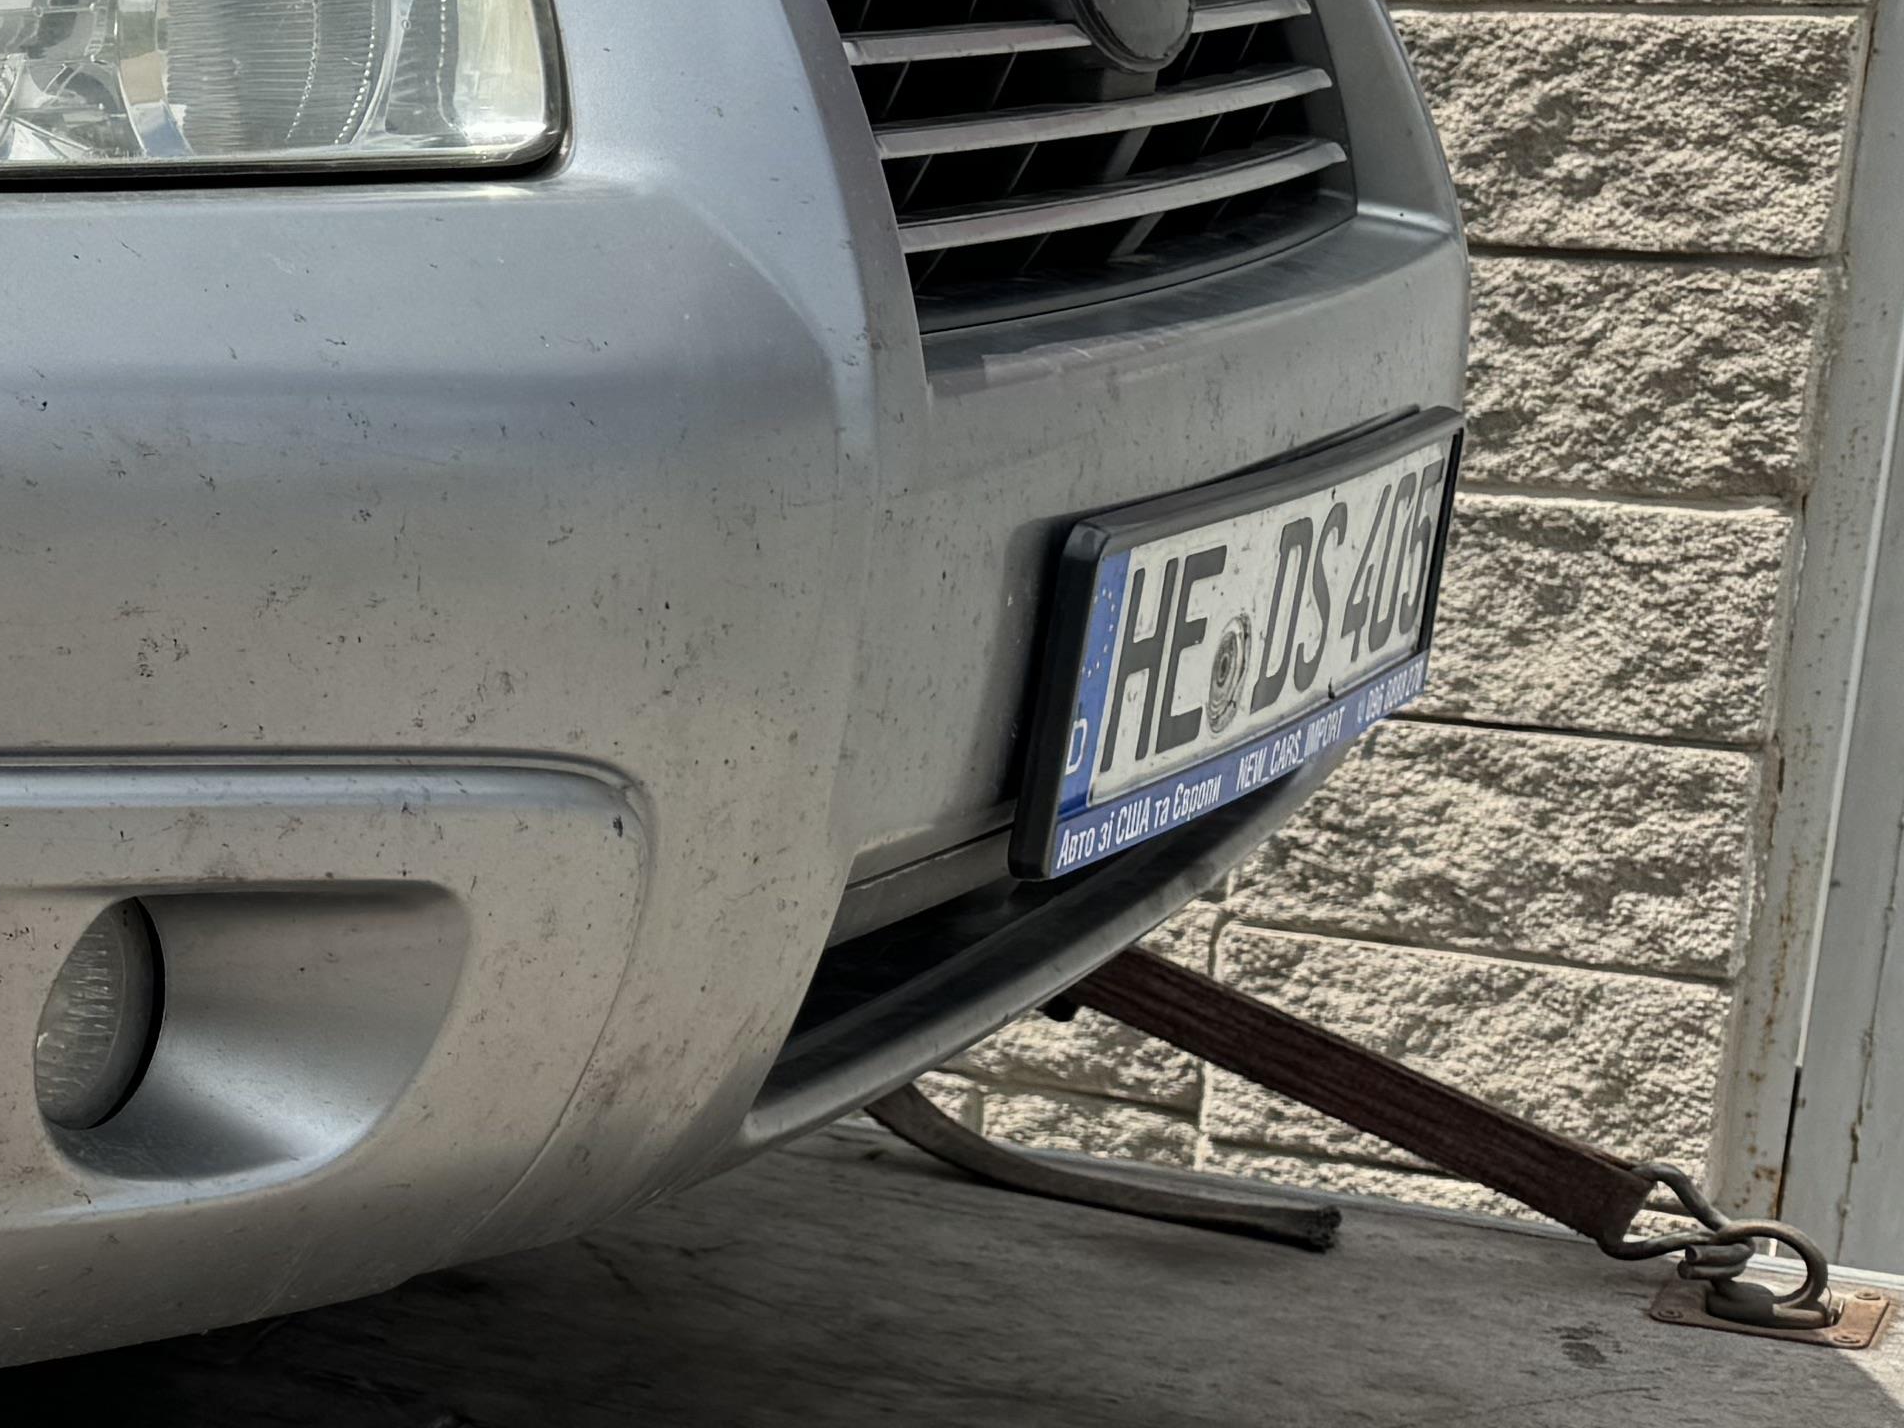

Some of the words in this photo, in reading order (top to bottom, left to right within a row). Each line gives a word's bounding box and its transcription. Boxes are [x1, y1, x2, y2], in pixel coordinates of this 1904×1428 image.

[1099, 544, 1228, 774] HE
[1249, 501, 1349, 715] DS
[1340, 457, 1446, 664] 405
[1064, 717, 1089, 776] D
[1055, 828, 1094, 870] Авто
[1098, 811, 1115, 853] зі
[1115, 796, 1151, 845] США
[1154, 797, 1169, 829] та
[1172, 774, 1223, 821] Європи
